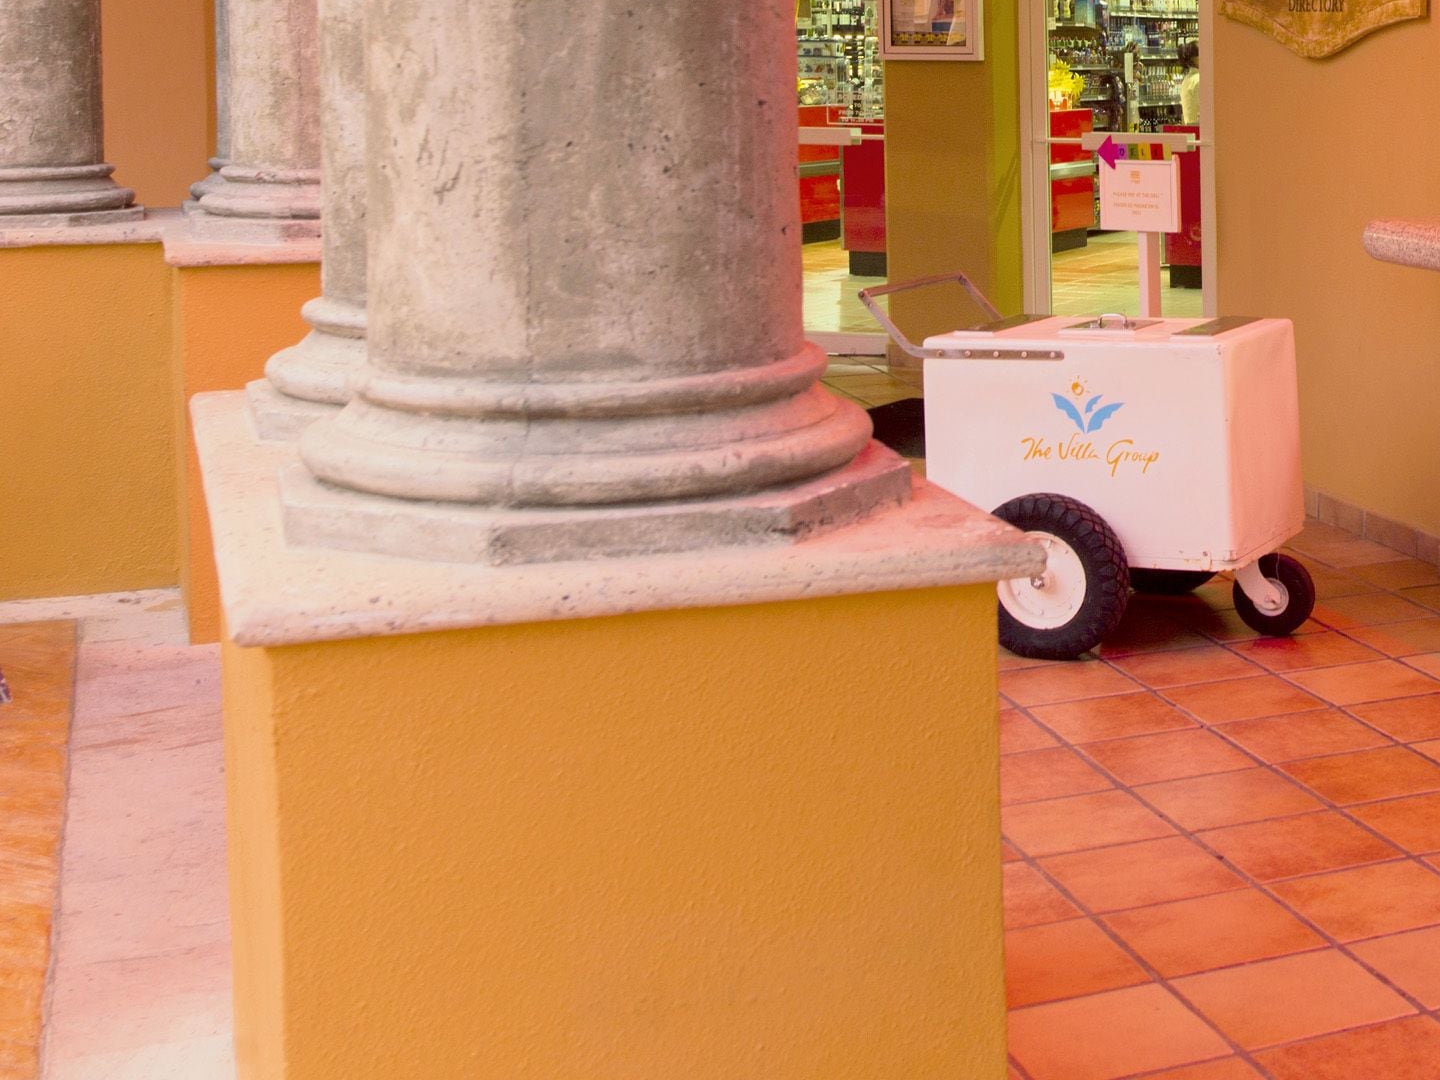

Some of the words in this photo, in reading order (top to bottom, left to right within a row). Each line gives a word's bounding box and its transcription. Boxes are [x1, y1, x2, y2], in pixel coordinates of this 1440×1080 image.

[1020, 436, 1051, 461] The
[1057, 432, 1100, 461] Villa
[1105, 438, 1160, 478] Group
